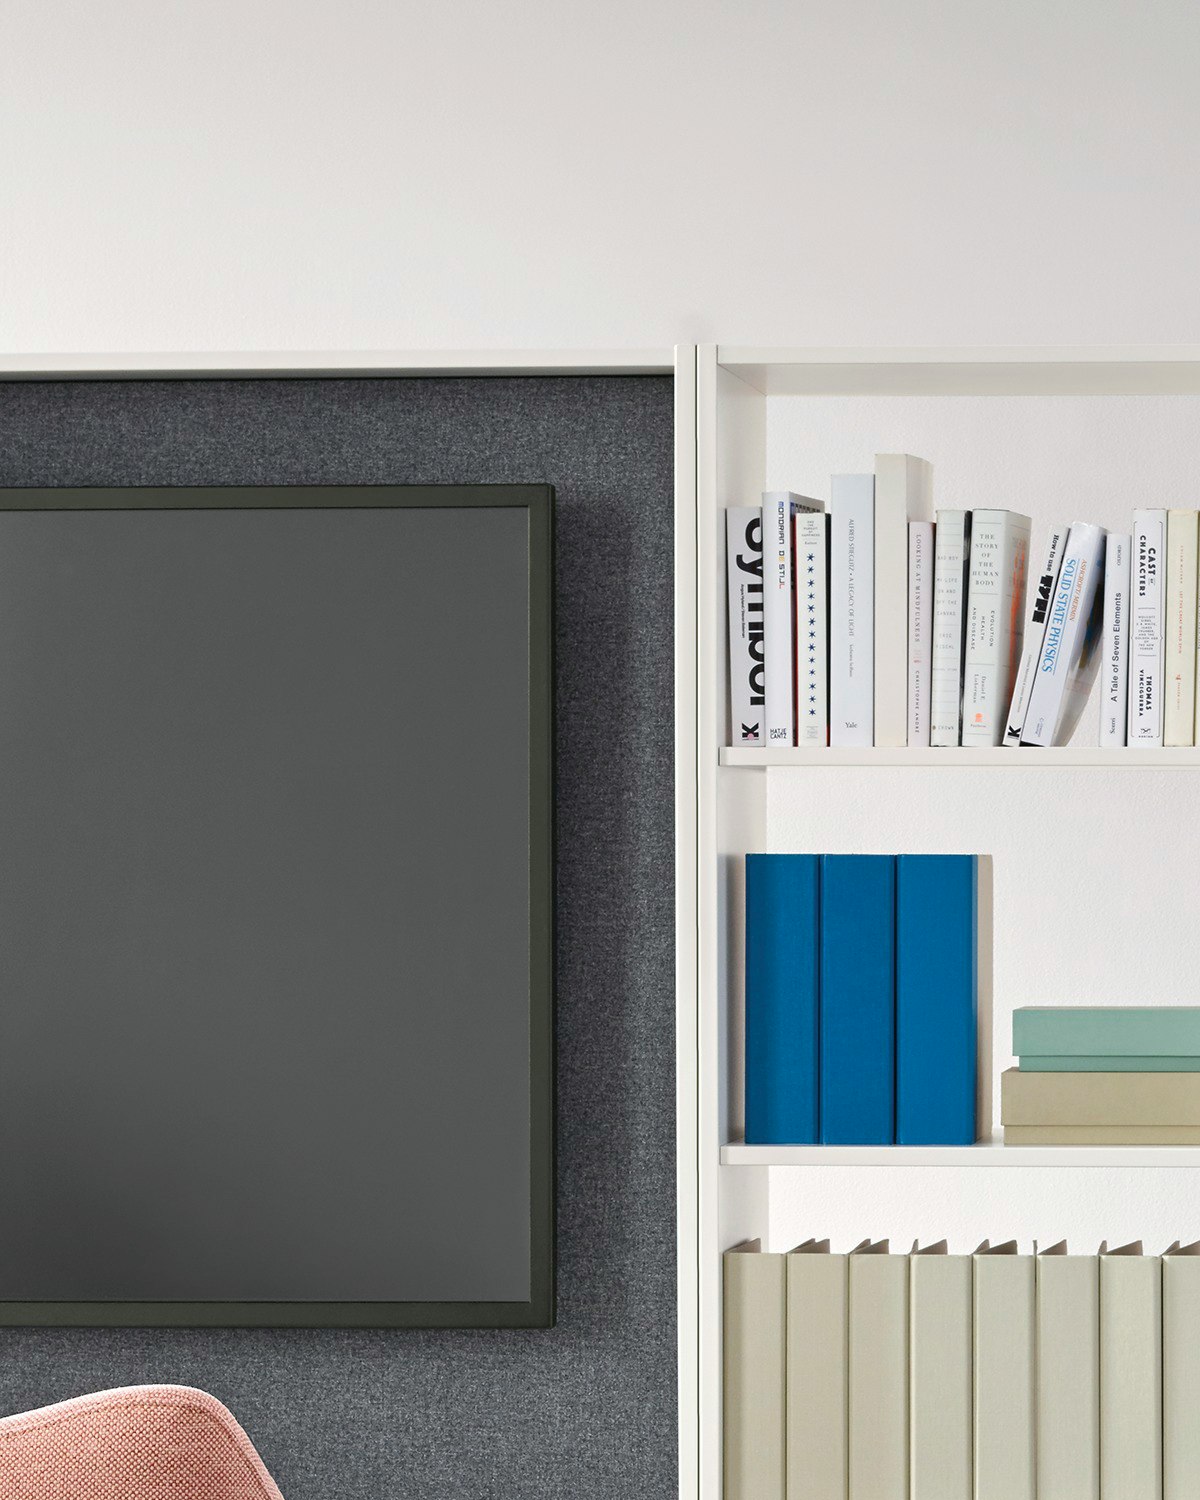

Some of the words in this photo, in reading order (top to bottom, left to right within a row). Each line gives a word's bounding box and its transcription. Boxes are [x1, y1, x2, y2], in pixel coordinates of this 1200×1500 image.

[1051, 534, 1059, 550] How
[1148, 547, 1156, 575] CAST
[916, 572, 921, 581] AT
[1060, 558, 1076, 590] SOLID
[848, 608, 855, 618] OF
[1052, 592, 1068, 625] STATE
[1113, 593, 1121, 632] Elements
[1041, 627, 1060, 673] PHYSICS
[1111, 664, 1119, 673] of
[1110, 676, 1119, 693] Tale
